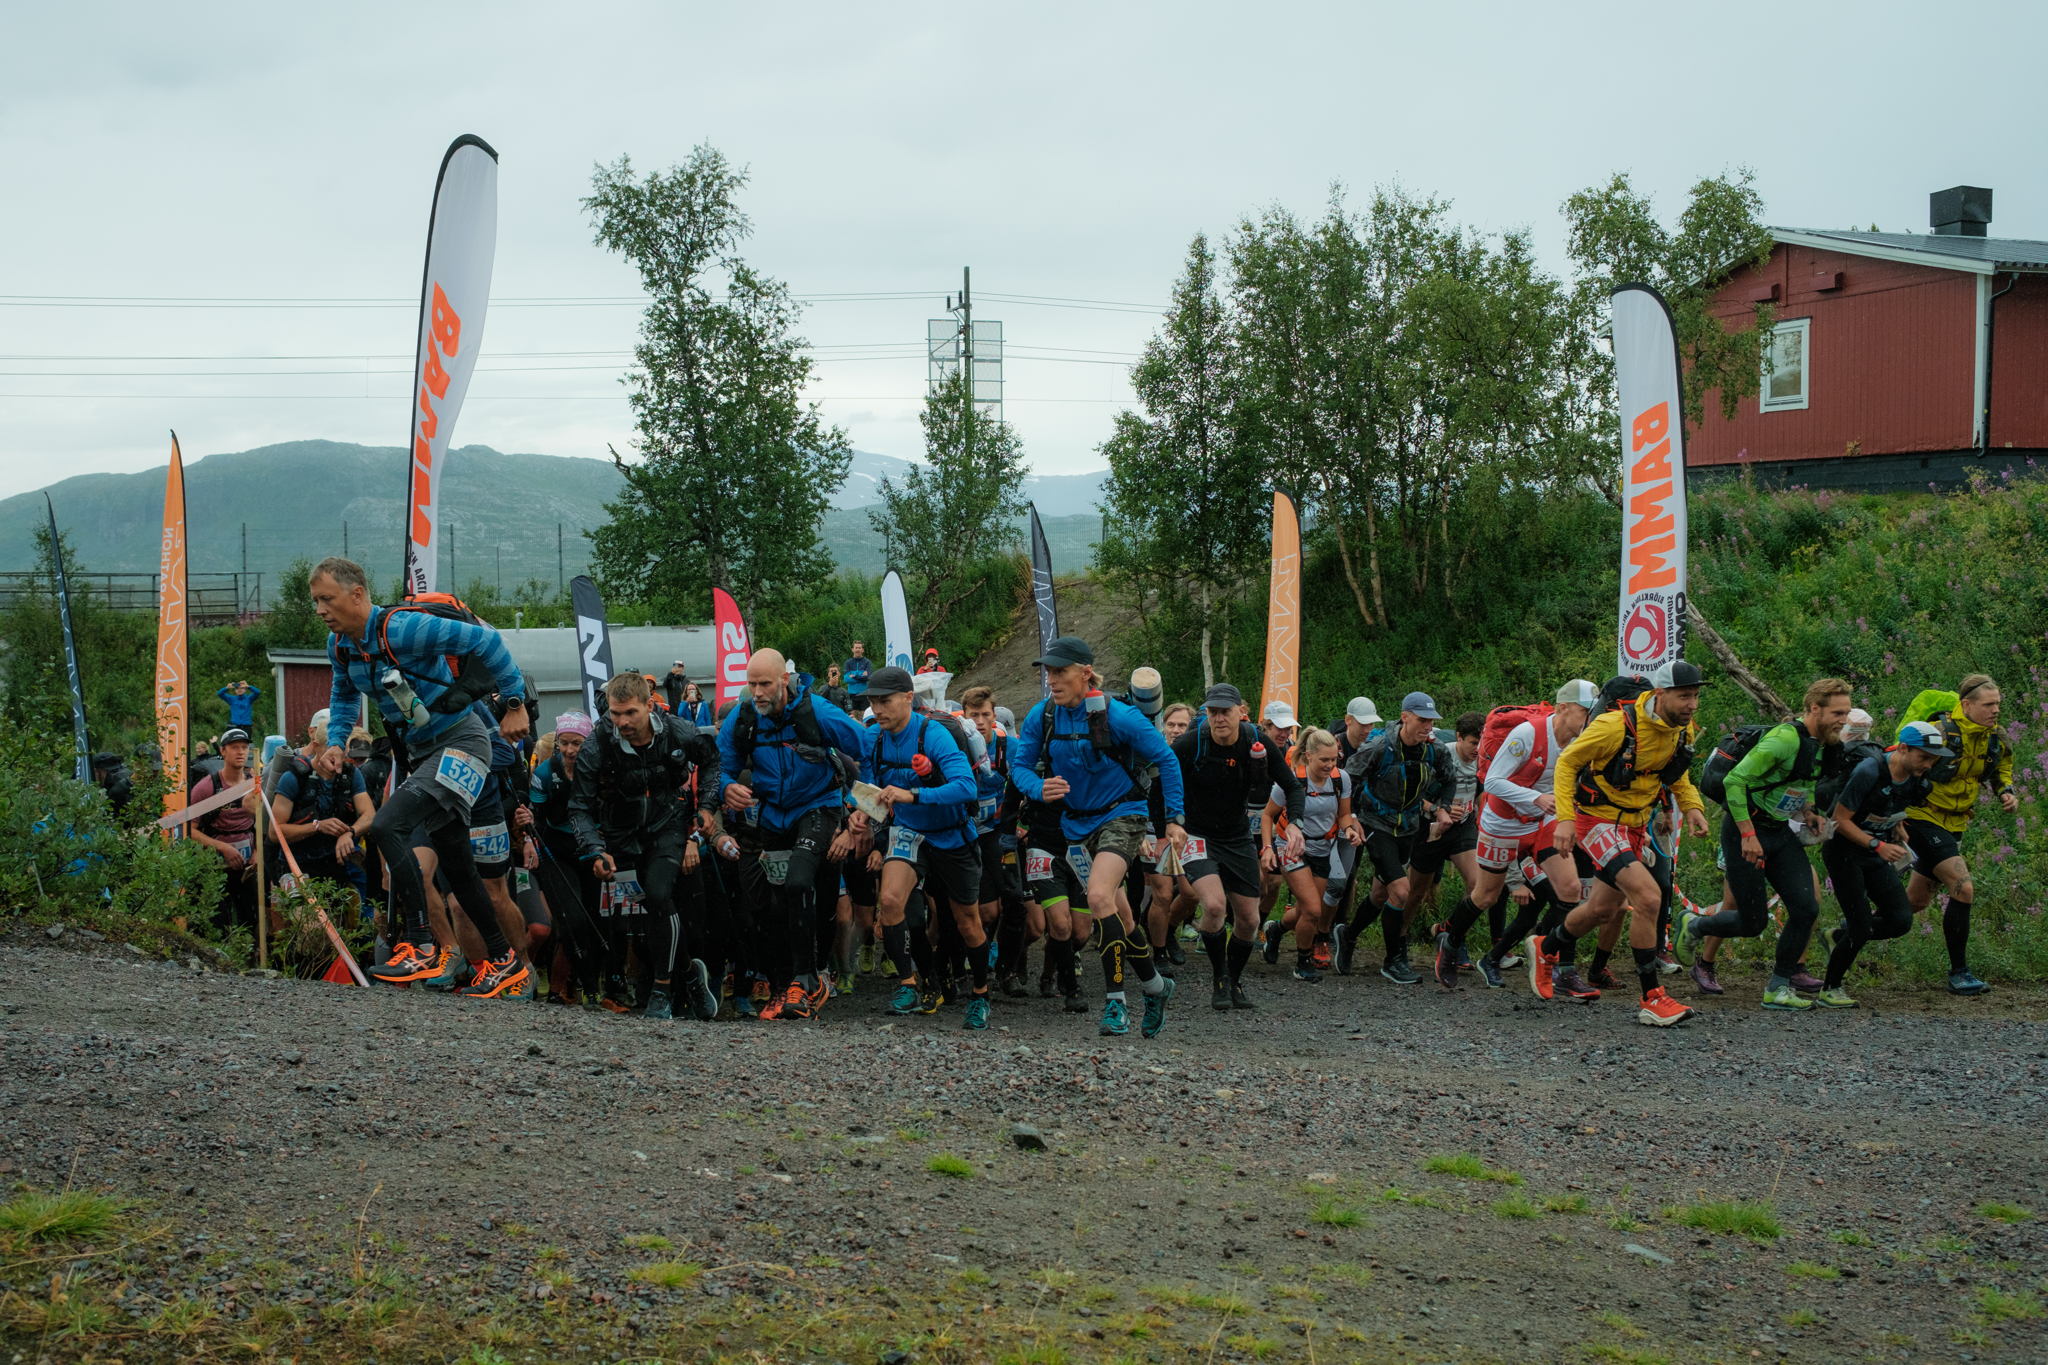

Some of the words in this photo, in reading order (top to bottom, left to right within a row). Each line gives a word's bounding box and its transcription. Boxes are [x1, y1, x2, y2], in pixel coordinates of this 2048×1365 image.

[413, 281, 462, 547] BAMM
[448, 758, 479, 794] 528
[475, 834, 506, 856] 542
[1484, 845, 1508, 862] 718
